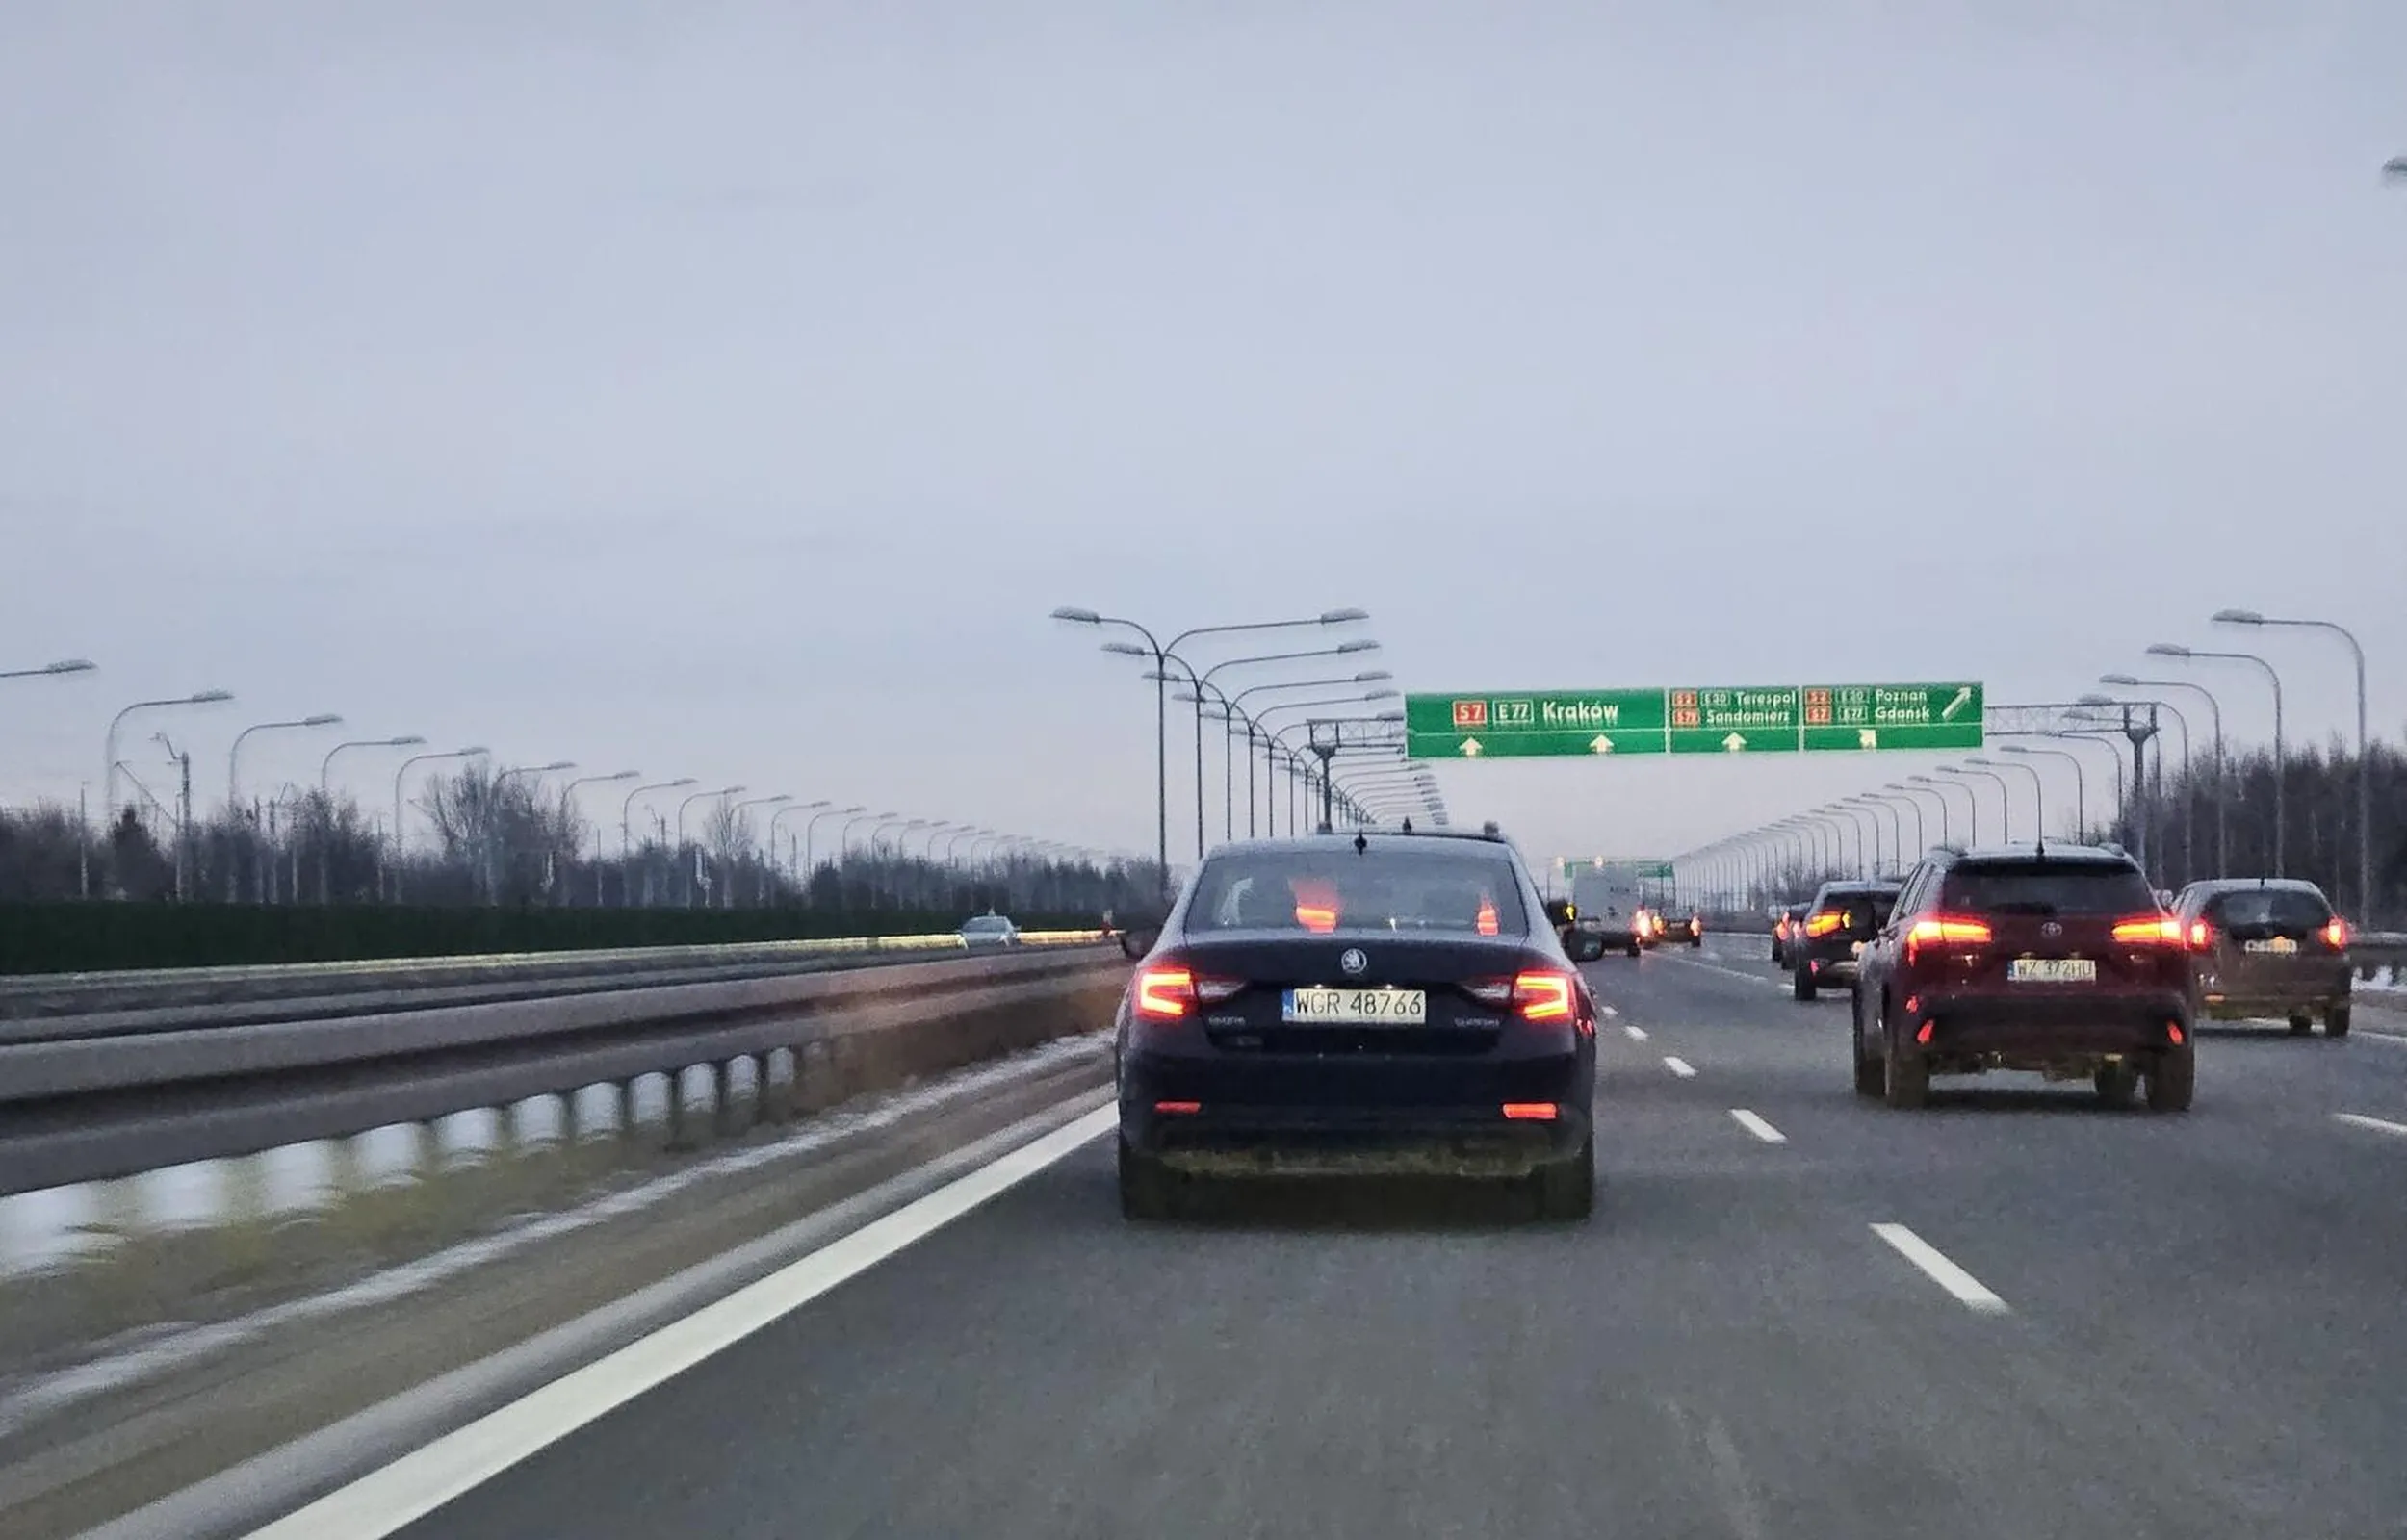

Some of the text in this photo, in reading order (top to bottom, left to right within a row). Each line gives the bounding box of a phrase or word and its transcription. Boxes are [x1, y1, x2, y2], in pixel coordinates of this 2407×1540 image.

[1736, 691, 1796, 709] Terespol
[1542, 700, 1618, 721] Kraków
[1707, 709, 1789, 724] Sandomierz
[1296, 991, 1422, 1015] WGR 48766
